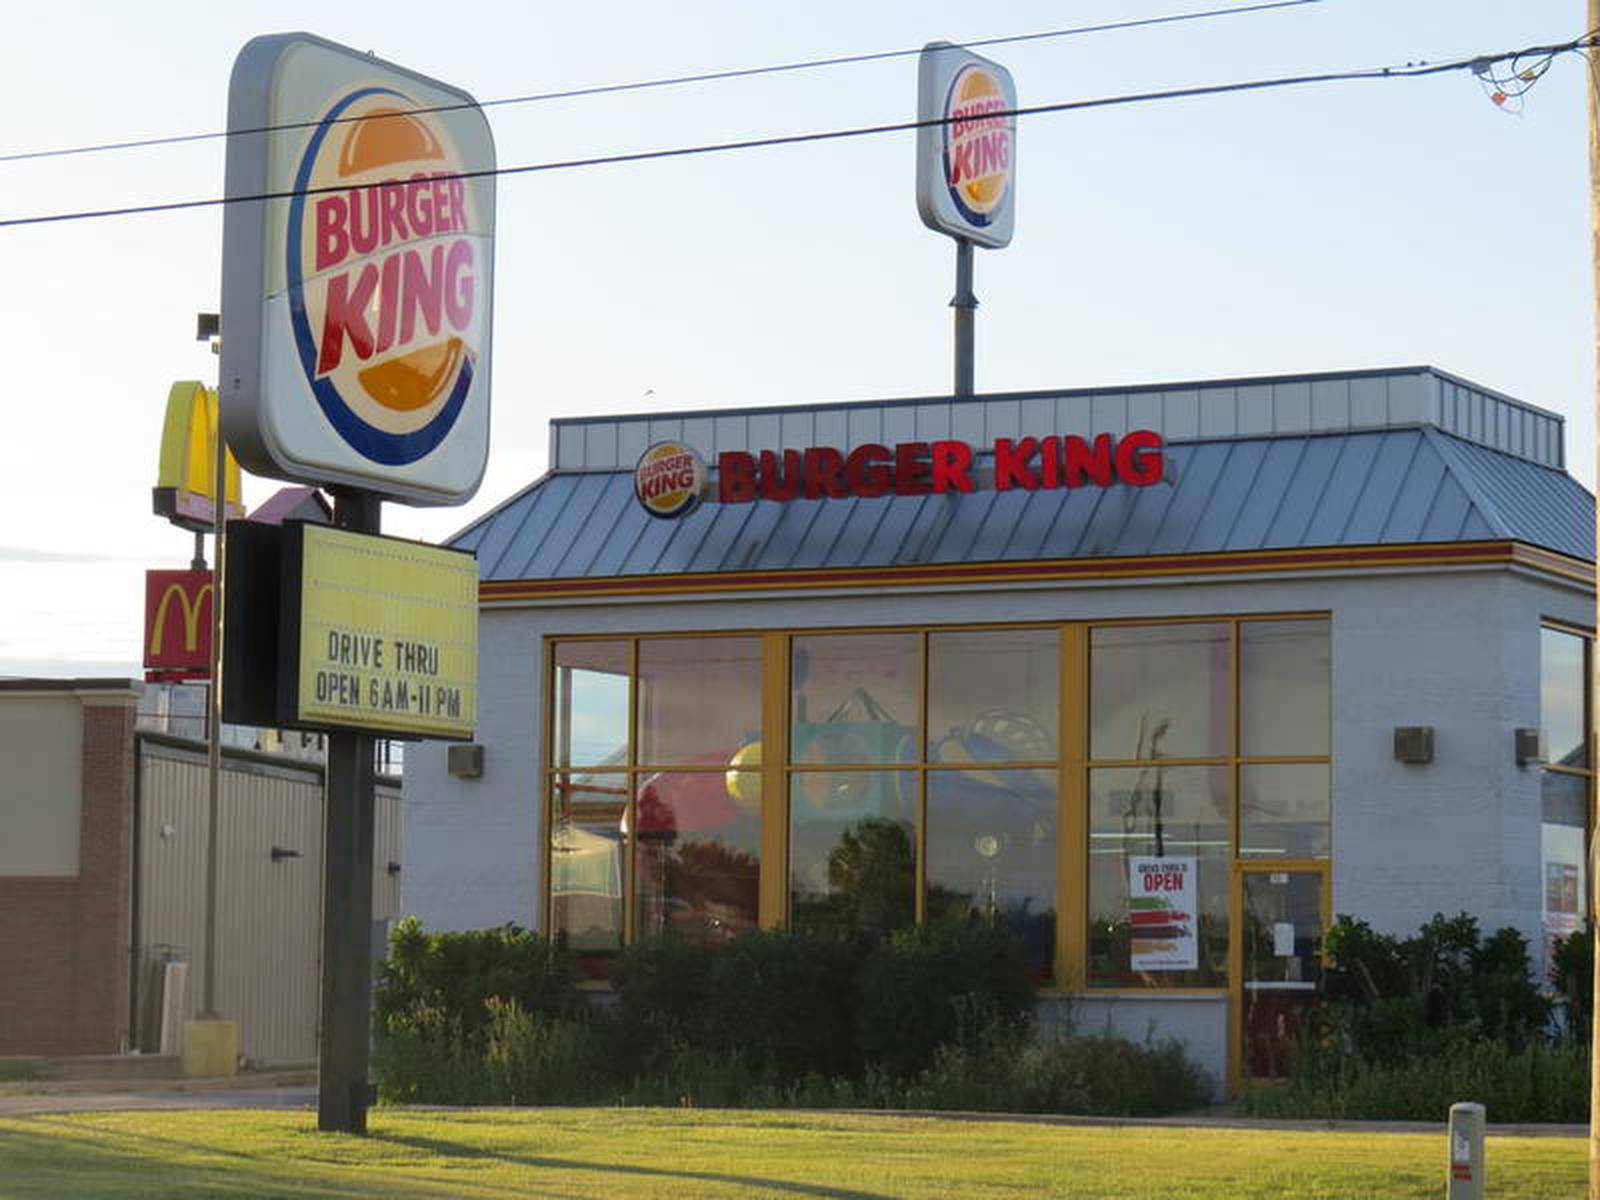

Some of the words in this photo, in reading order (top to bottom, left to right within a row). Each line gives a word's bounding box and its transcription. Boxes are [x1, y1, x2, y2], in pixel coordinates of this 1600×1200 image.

[953, 98, 1008, 140] BURGER
[951, 131, 1009, 185] KING
[315, 171, 467, 271] BURGER
[315, 239, 474, 376] KING
[639, 454, 693, 478] BURGER
[640, 468, 694, 502] KING
[717, 441, 973, 504] BURGER
[993, 429, 1163, 492] KING
[328, 630, 383, 668] DRIVE
[394, 641, 439, 676] THRU
[316, 671, 360, 706] OPEN
[1143, 872, 1184, 892] OPEN
